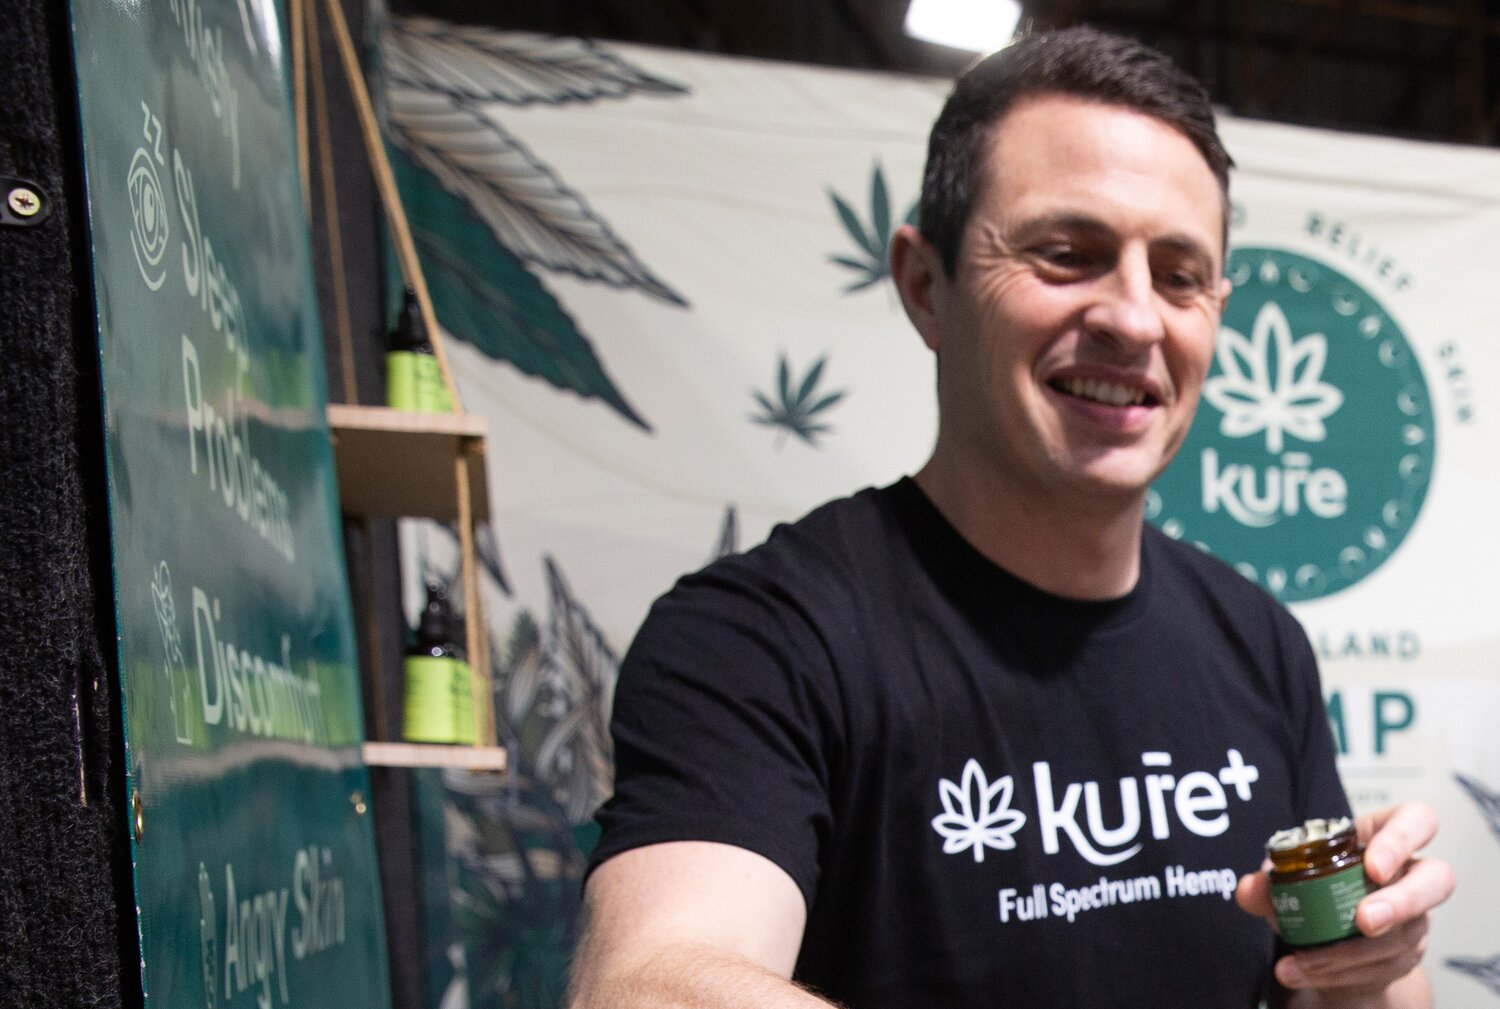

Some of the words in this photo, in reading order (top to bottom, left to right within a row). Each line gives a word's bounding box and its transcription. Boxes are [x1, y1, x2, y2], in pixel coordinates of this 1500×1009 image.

[1318, 628, 1422, 662] LAND
[292, 845, 345, 960] Skin
[998, 884, 1048, 923] Full
[1050, 876, 1161, 923] Spectrum
[1165, 864, 1237, 901] Hemp
